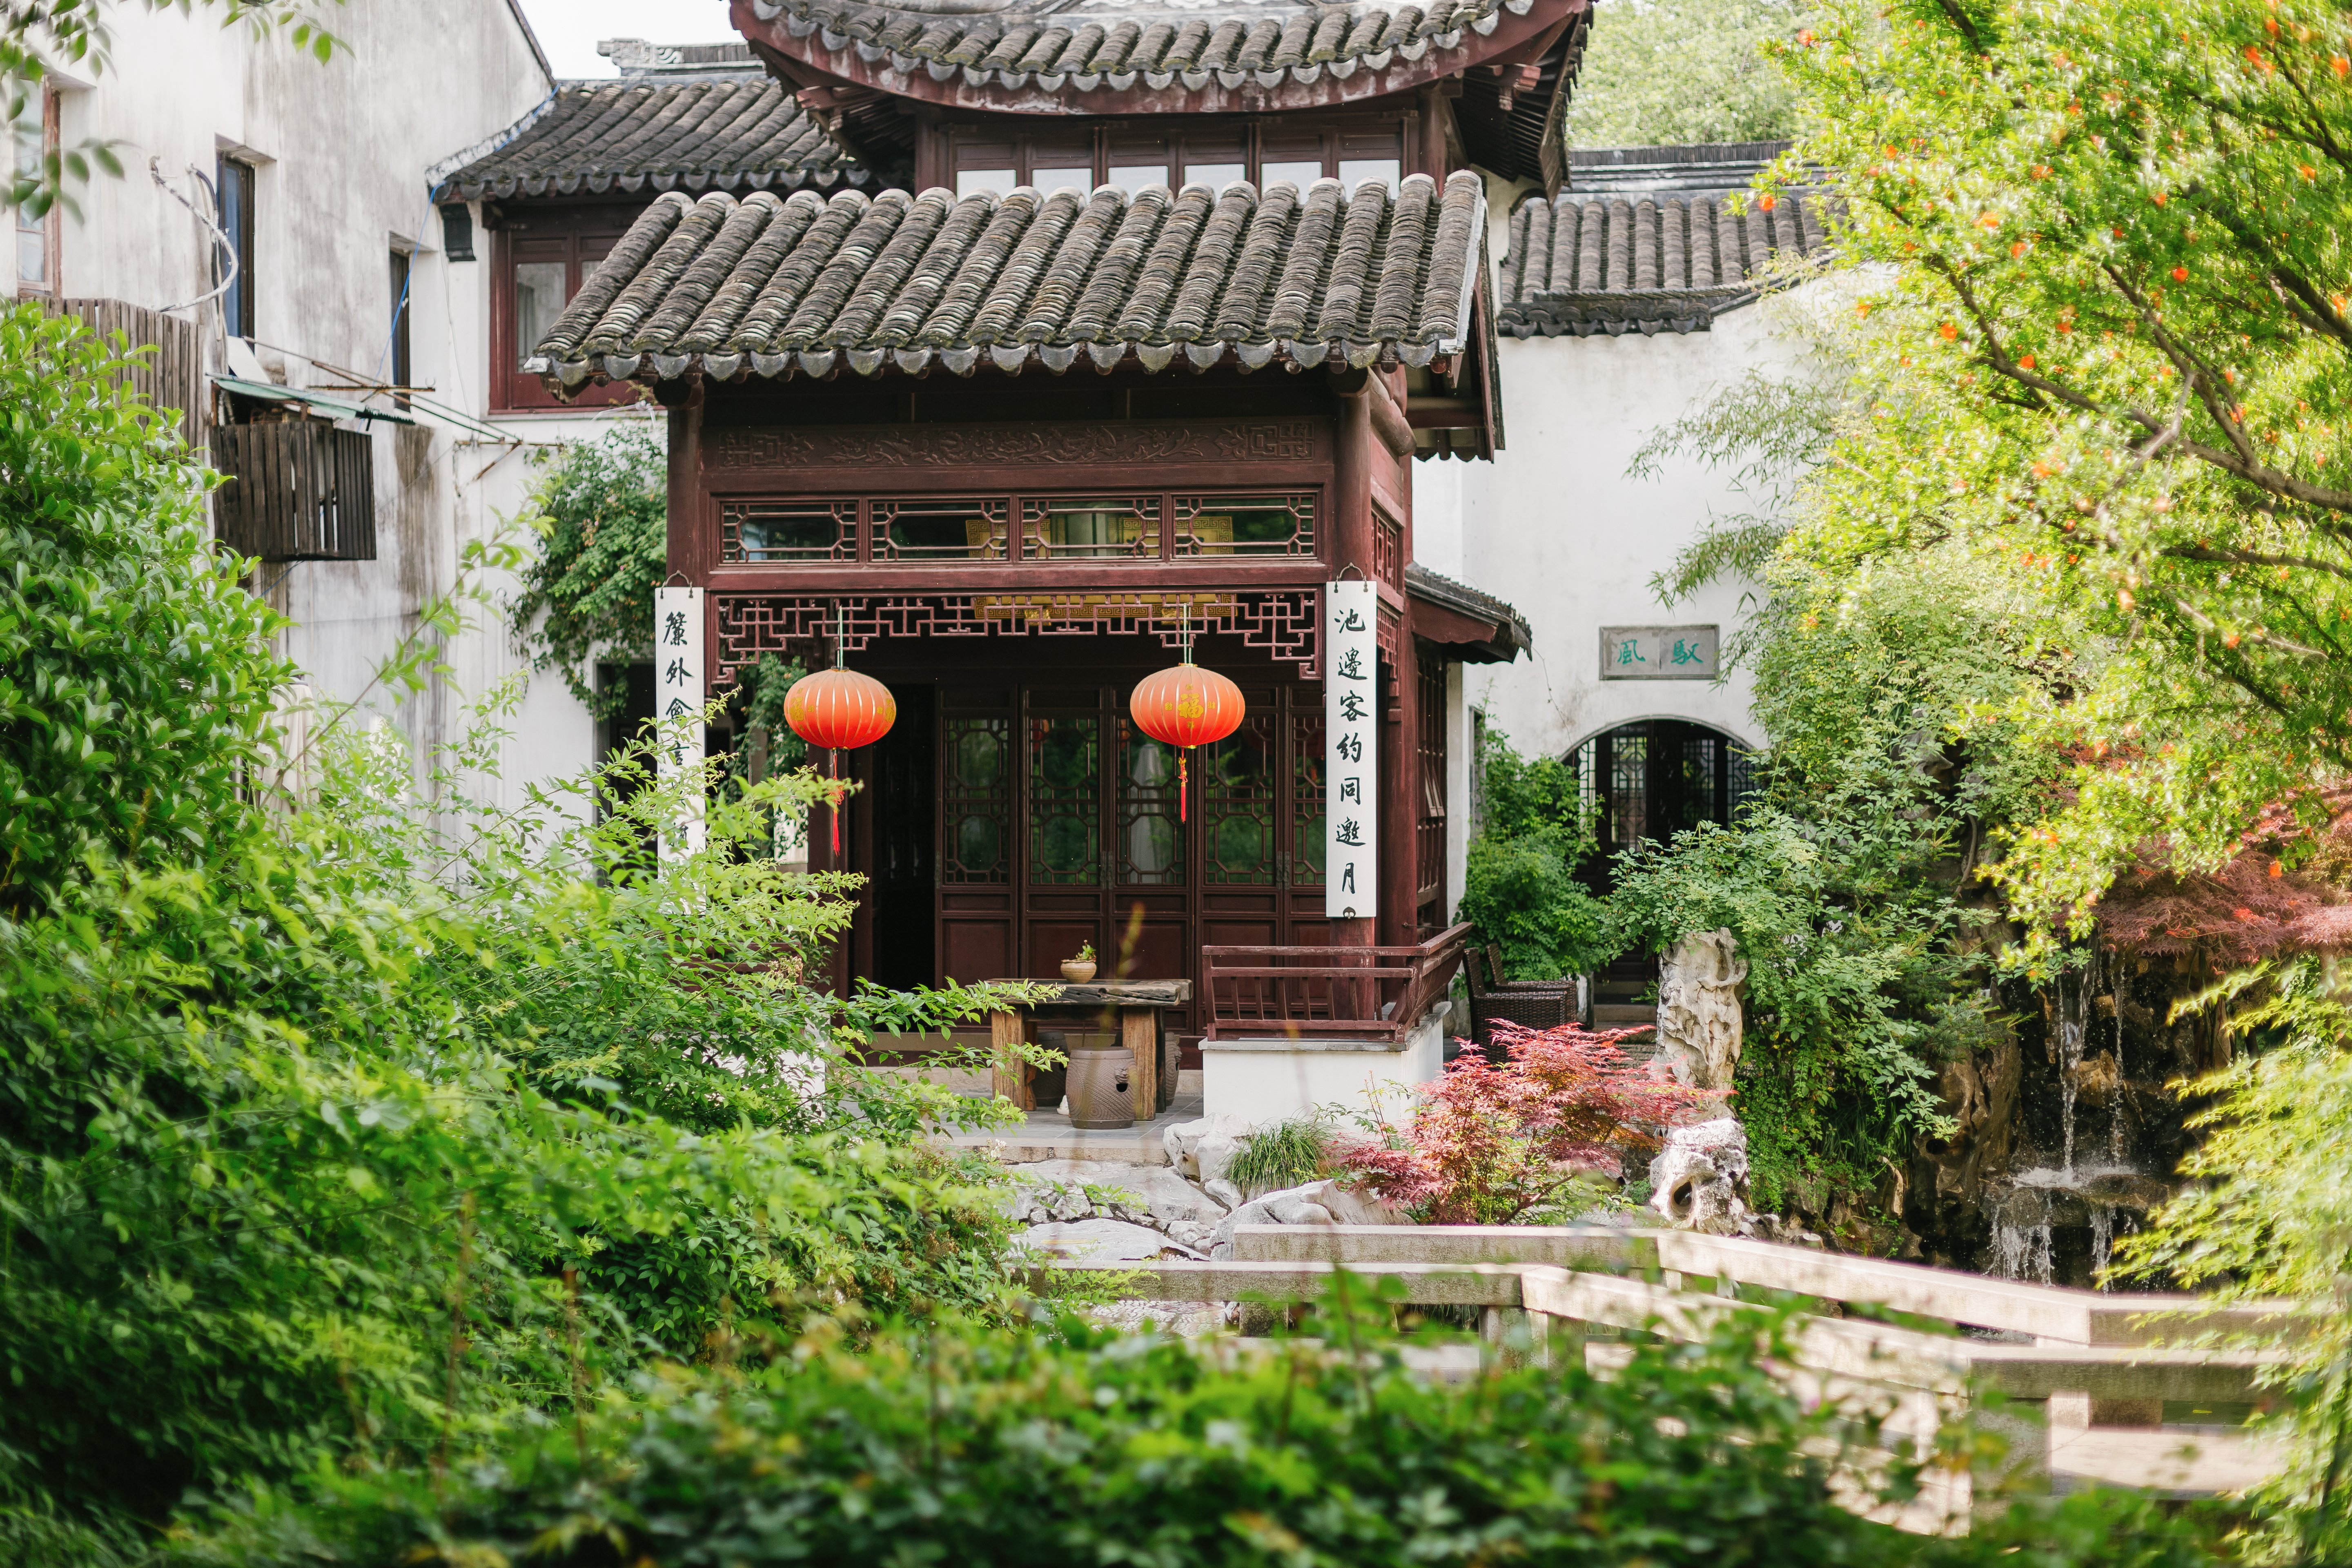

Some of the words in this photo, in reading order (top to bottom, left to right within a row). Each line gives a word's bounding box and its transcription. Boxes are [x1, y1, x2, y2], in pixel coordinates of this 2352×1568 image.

[1177, 693, 1204, 718] 福
[1334, 608, 1369, 894] 池邊客約同邀月
